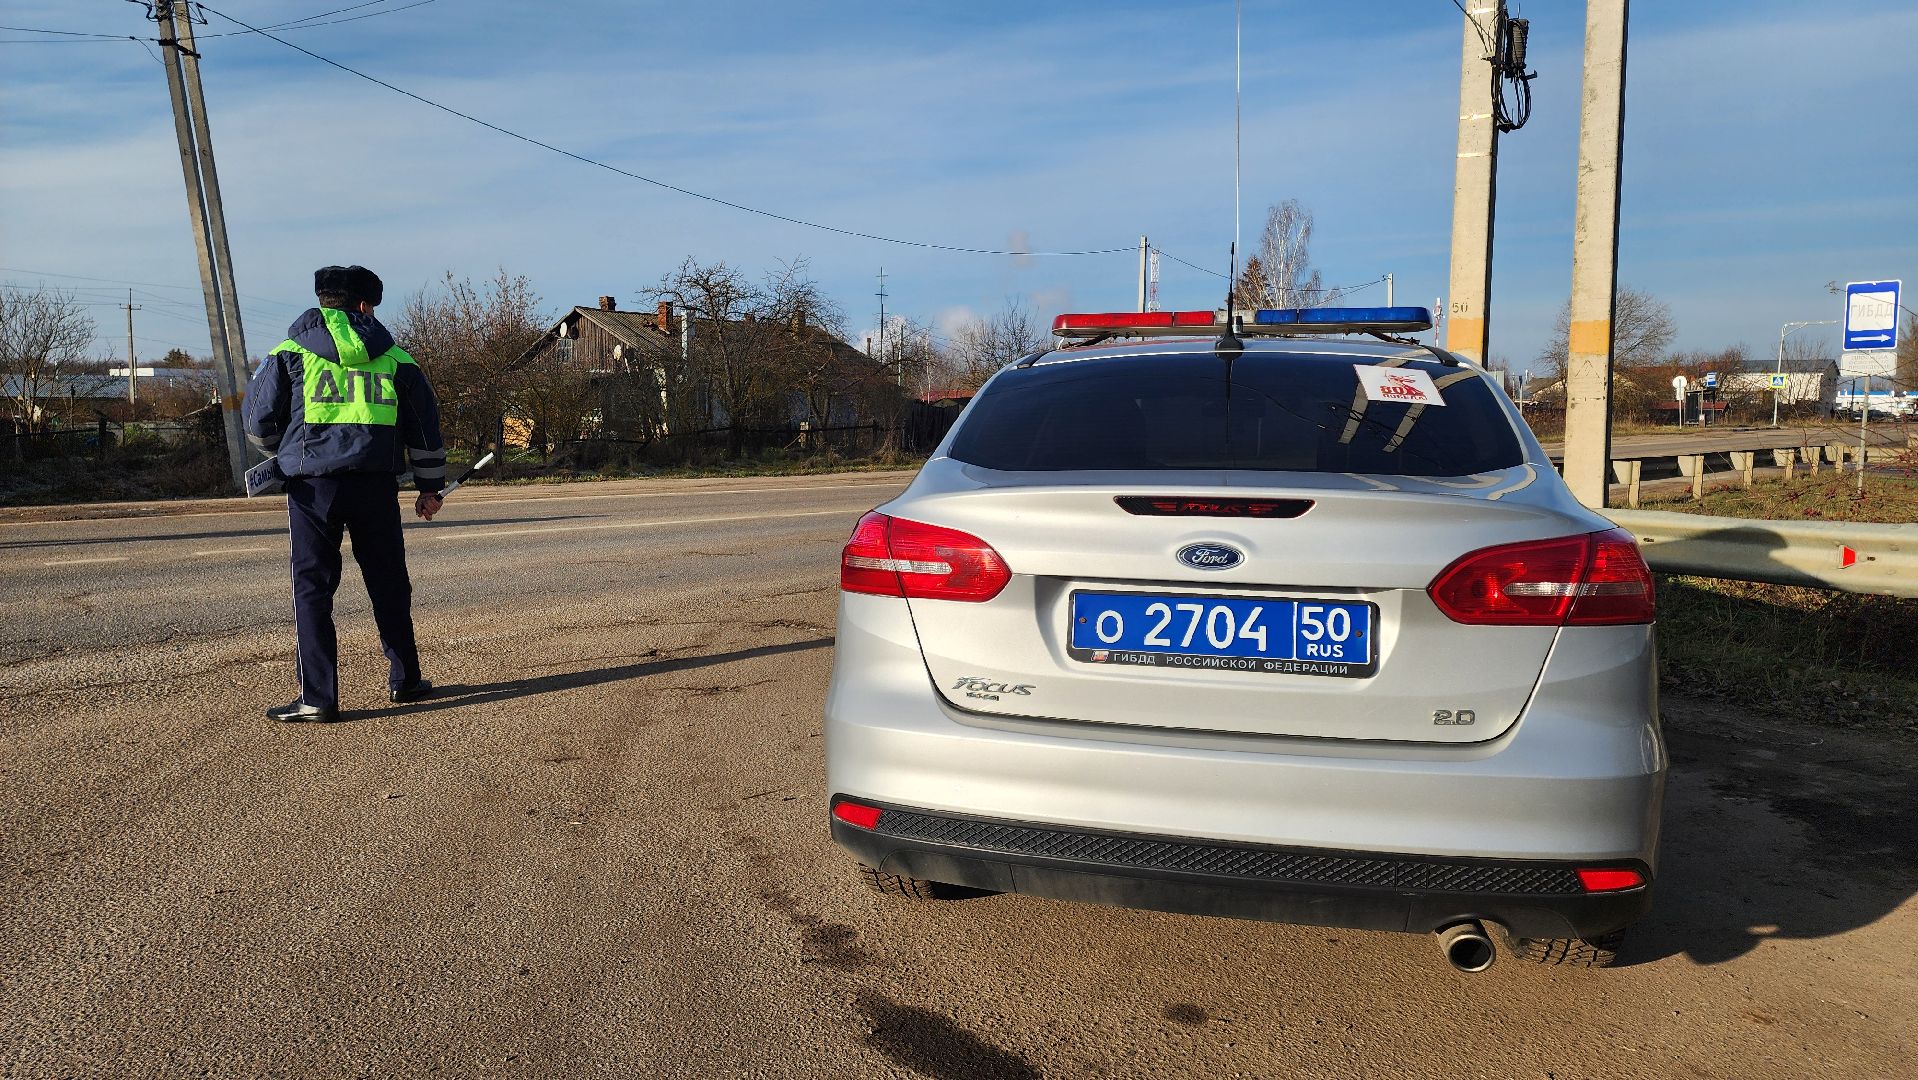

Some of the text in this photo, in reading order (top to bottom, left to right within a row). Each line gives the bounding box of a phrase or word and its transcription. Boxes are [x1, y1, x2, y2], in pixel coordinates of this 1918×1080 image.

[1851, 304, 1893, 318] ГИБДД
[311, 369, 397, 405] ДПС
[1192, 548, 1229, 564] Ford
[1096, 602, 1351, 652] О 2704 50
[1306, 643, 1344, 658] RUS
[1113, 653, 1349, 675] ГИБДД РОССИЙСКОЙ ФЕДЕРАЦИИ
[1433, 709, 1476, 726] 2.0
